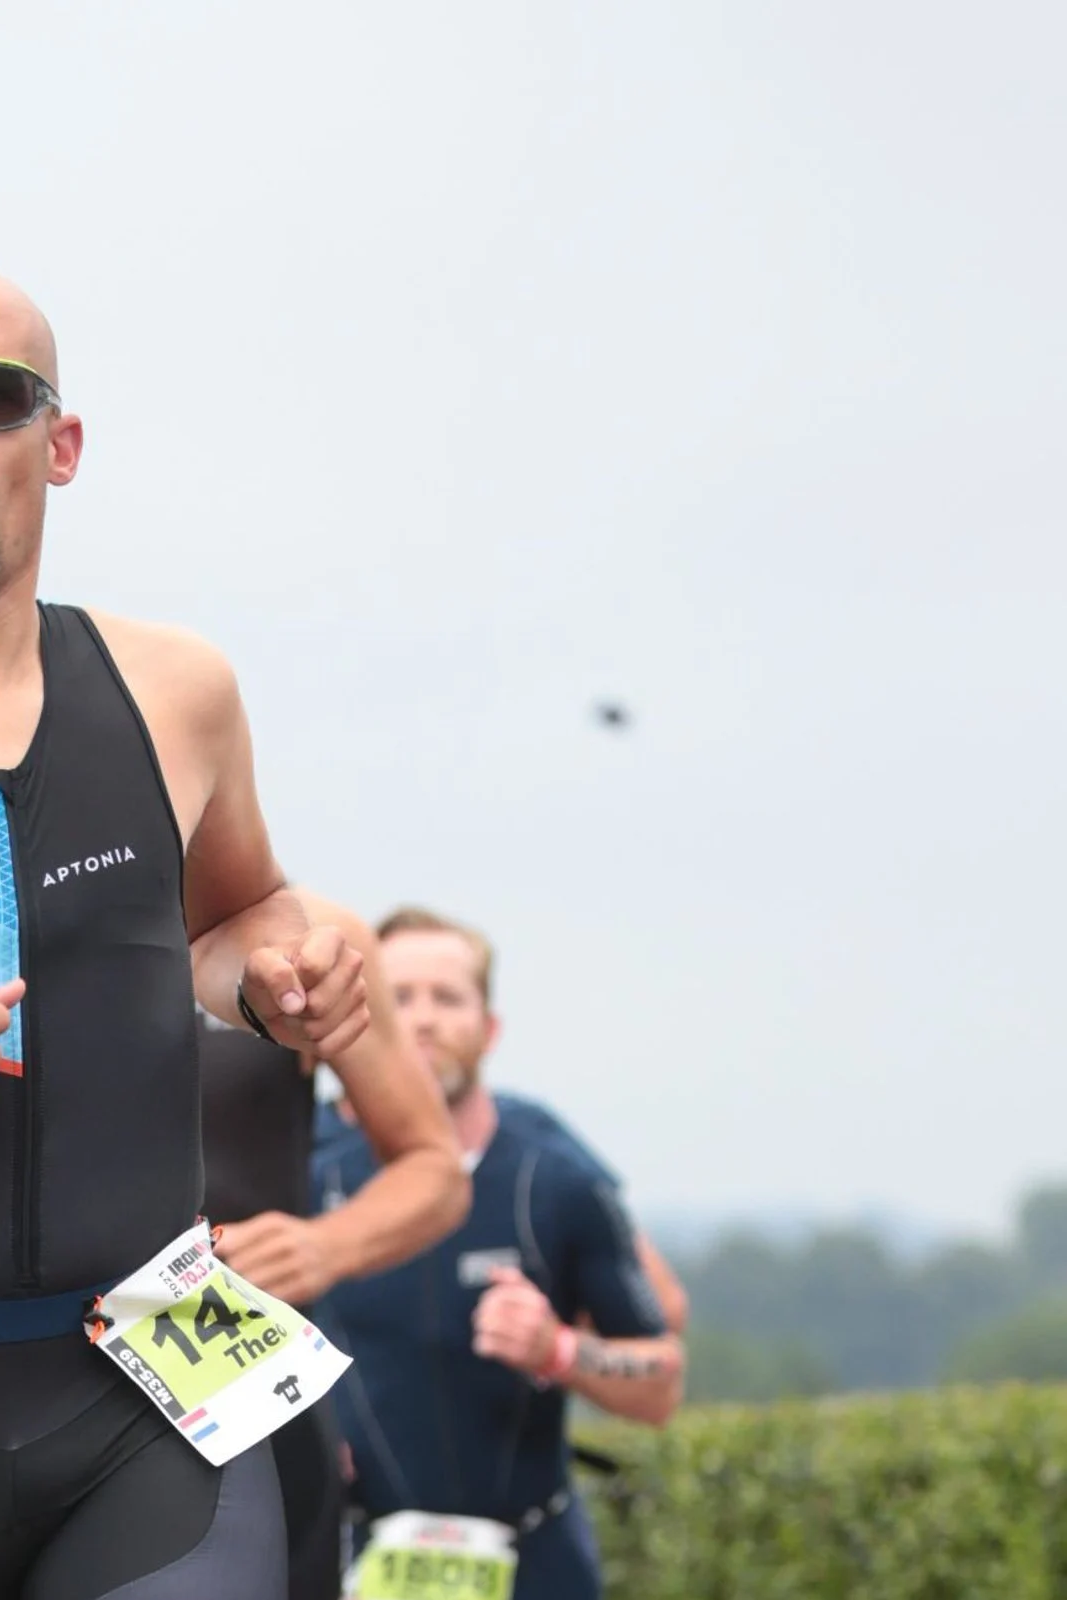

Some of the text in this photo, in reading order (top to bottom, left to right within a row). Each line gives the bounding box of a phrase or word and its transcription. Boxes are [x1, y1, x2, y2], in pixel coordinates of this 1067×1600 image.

[43, 846, 136, 888] APTONIA
[158, 1270, 184, 1299] 2021
[178, 1262, 208, 1290] 70.3
[151, 1284, 266, 1366] 14
[119, 1349, 173, 1405] M35-39
